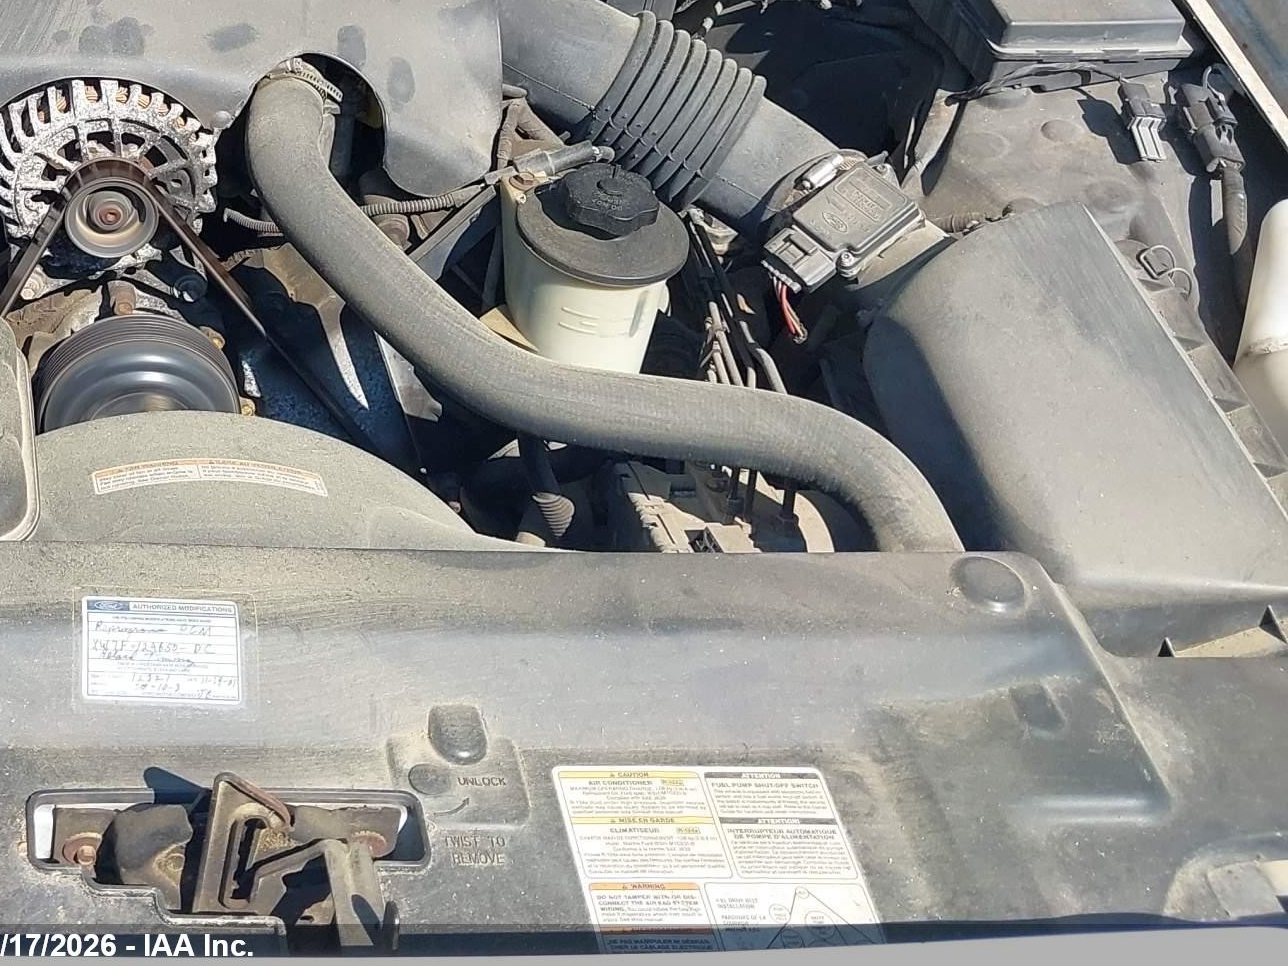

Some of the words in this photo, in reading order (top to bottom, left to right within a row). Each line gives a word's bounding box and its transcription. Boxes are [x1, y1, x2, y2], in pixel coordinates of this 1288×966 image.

[457, 776, 507, 787] UNLOCK
[444, 835, 480, 848] TWIST
[490, 835, 506, 848] TO
[451, 851, 506, 865] REMOVE
